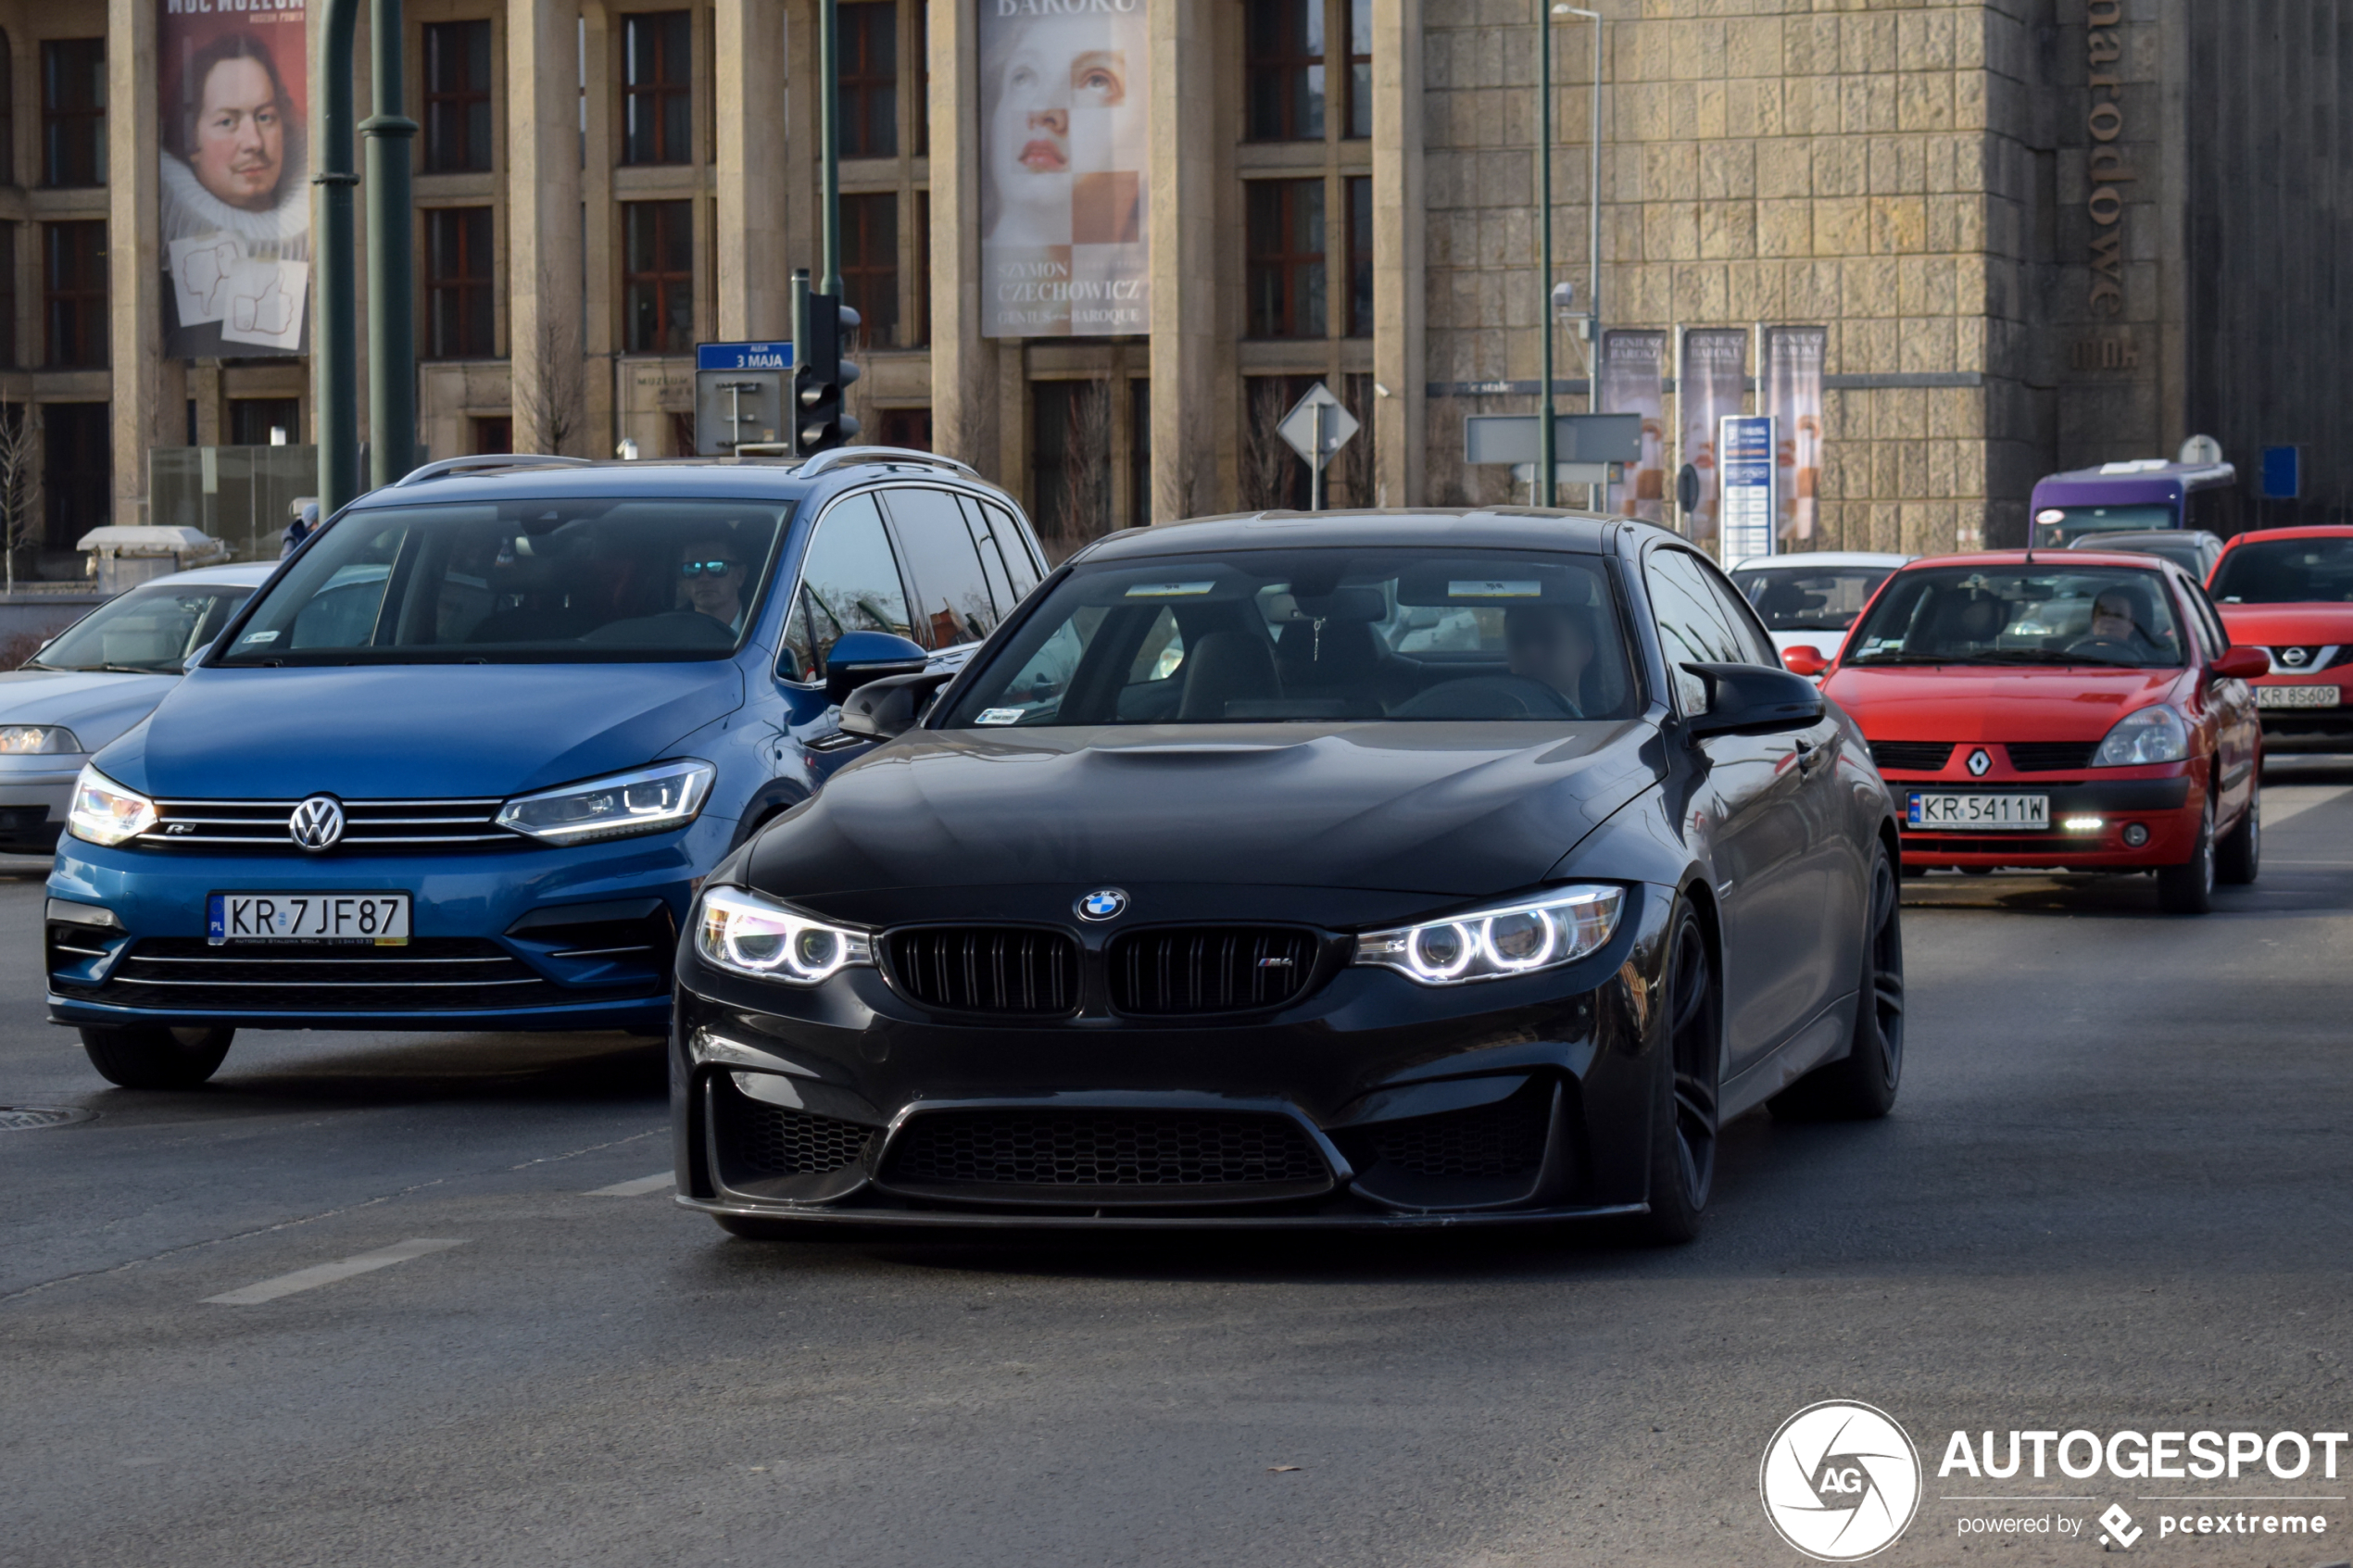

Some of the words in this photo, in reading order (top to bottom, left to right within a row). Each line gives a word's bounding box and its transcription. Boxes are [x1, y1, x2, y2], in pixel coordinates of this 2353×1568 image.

[2088, 0, 2138, 316] narodowe
[998, 262, 1068, 278] SZYMON
[998, 280, 1139, 302] CZECHOWICZ
[998, 310, 1052, 324] GENIUS
[1072, 308, 1139, 324] BAROQUE
[736, 355, 745, 369] 3
[748, 354, 783, 368] MAJA
[1925, 797, 1958, 821] KR
[1969, 797, 2043, 821] 5411W
[232, 899, 275, 935] KR
[290, 899, 399, 935] 7JF87
[210, 922, 223, 932] PL
